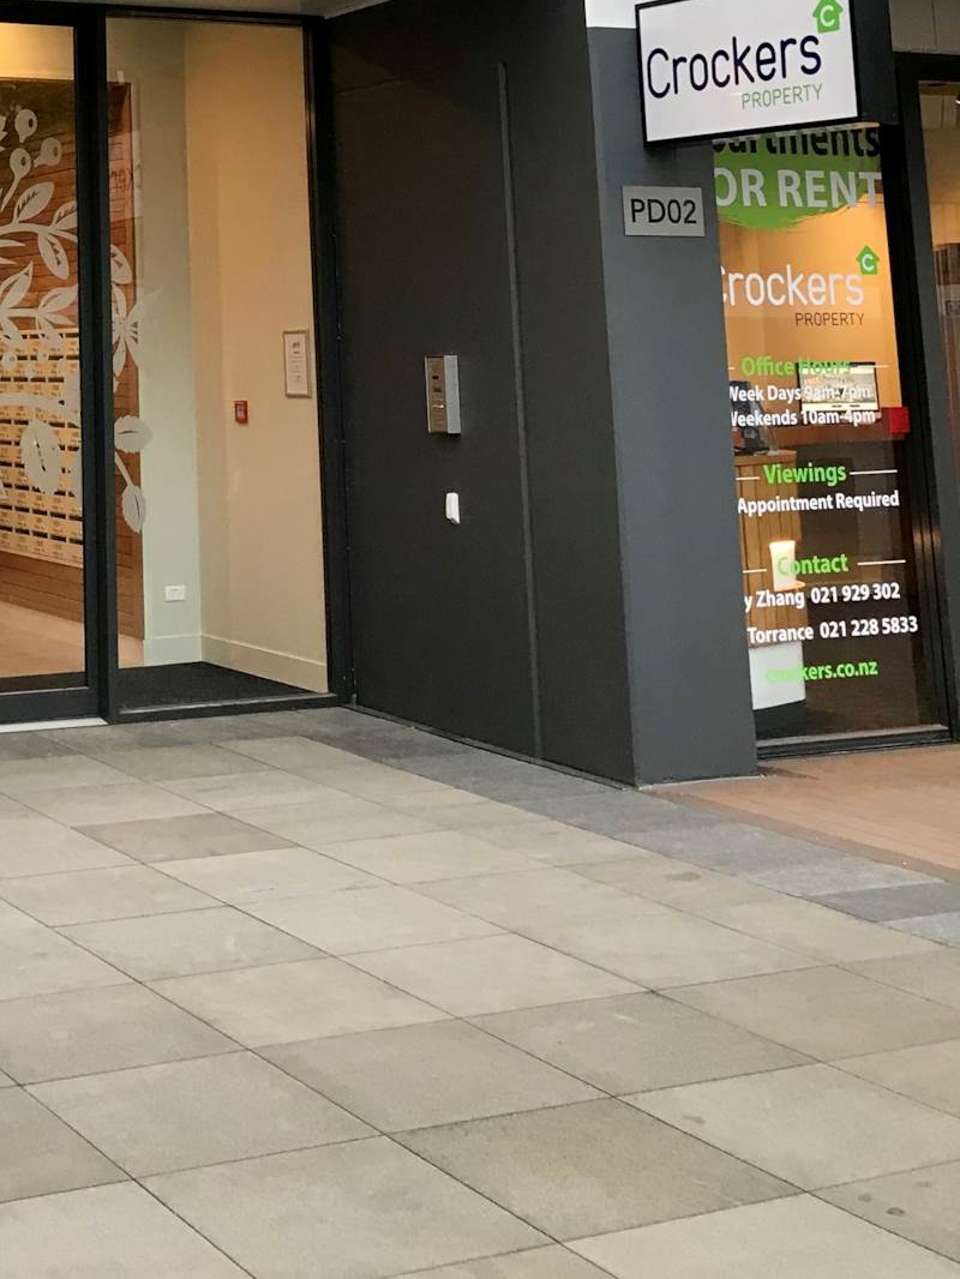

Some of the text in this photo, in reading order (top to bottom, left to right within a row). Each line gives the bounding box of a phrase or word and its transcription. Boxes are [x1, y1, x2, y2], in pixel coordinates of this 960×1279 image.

[820, 4, 835, 27] C
[647, 35, 822, 99] Crockers
[742, 83, 823, 109] PROPERTY
[777, 169, 882, 209] RENT
[630, 198, 697, 224] PD02
[721, 264, 865, 306] rockers
[795, 312, 865, 327] PROPERTY
[741, 356, 795, 377] Office
[767, 385, 801, 404] Days
[801, 409, 876, 427] 10am-4pm
[763, 462, 847, 487] Viewings
[737, 489, 900, 517] Appointment Required
[777, 553, 849, 576] Contact
[755, 589, 805, 609] Zhang
[810, 587, 839, 604] 021
[842, 585, 870, 602] 929
[872, 582, 901, 600] 302
[746, 615, 918, 644] Torrance 021 228 5833
